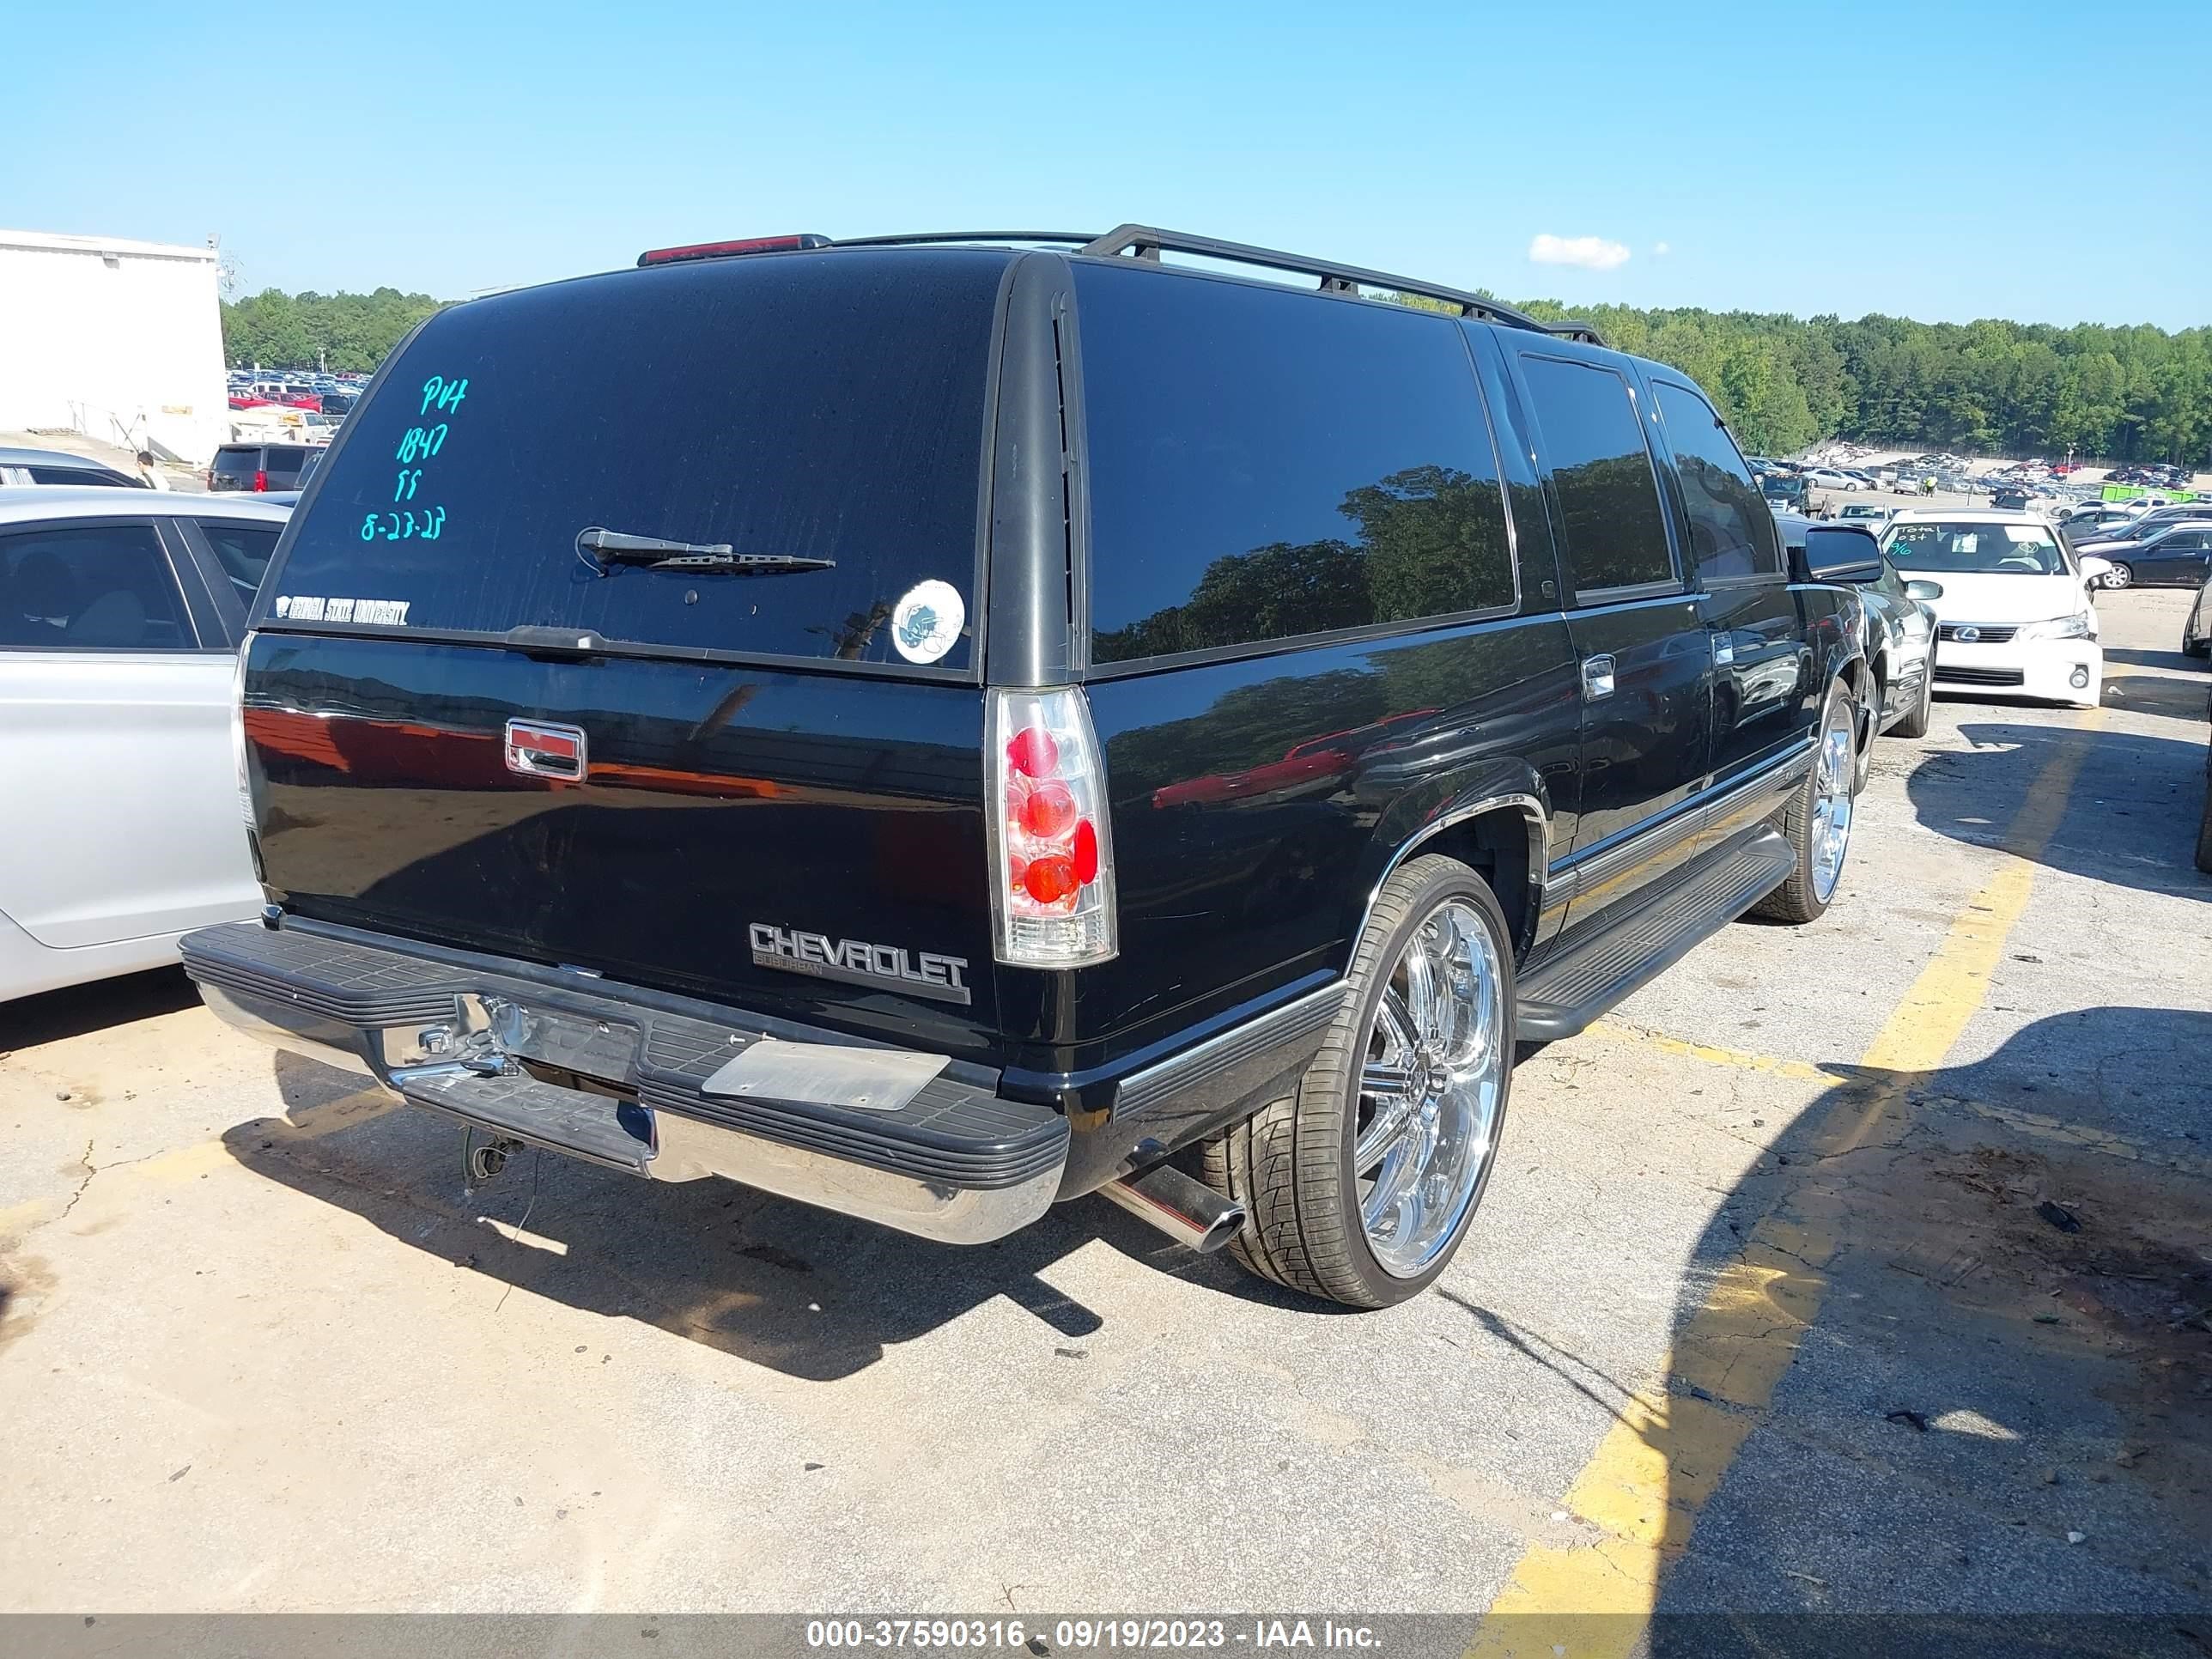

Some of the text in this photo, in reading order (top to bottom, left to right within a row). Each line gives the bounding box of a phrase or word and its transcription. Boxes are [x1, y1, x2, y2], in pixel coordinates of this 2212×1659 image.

[396, 423, 448, 464] 1847
[1896, 525, 1941, 533] Total
[324, 598, 355, 623] STATE
[352, 599, 410, 626] UNIVERSITY
[750, 922, 969, 988] CHEVROLET
[753, 951, 823, 976] SUBURBAN
